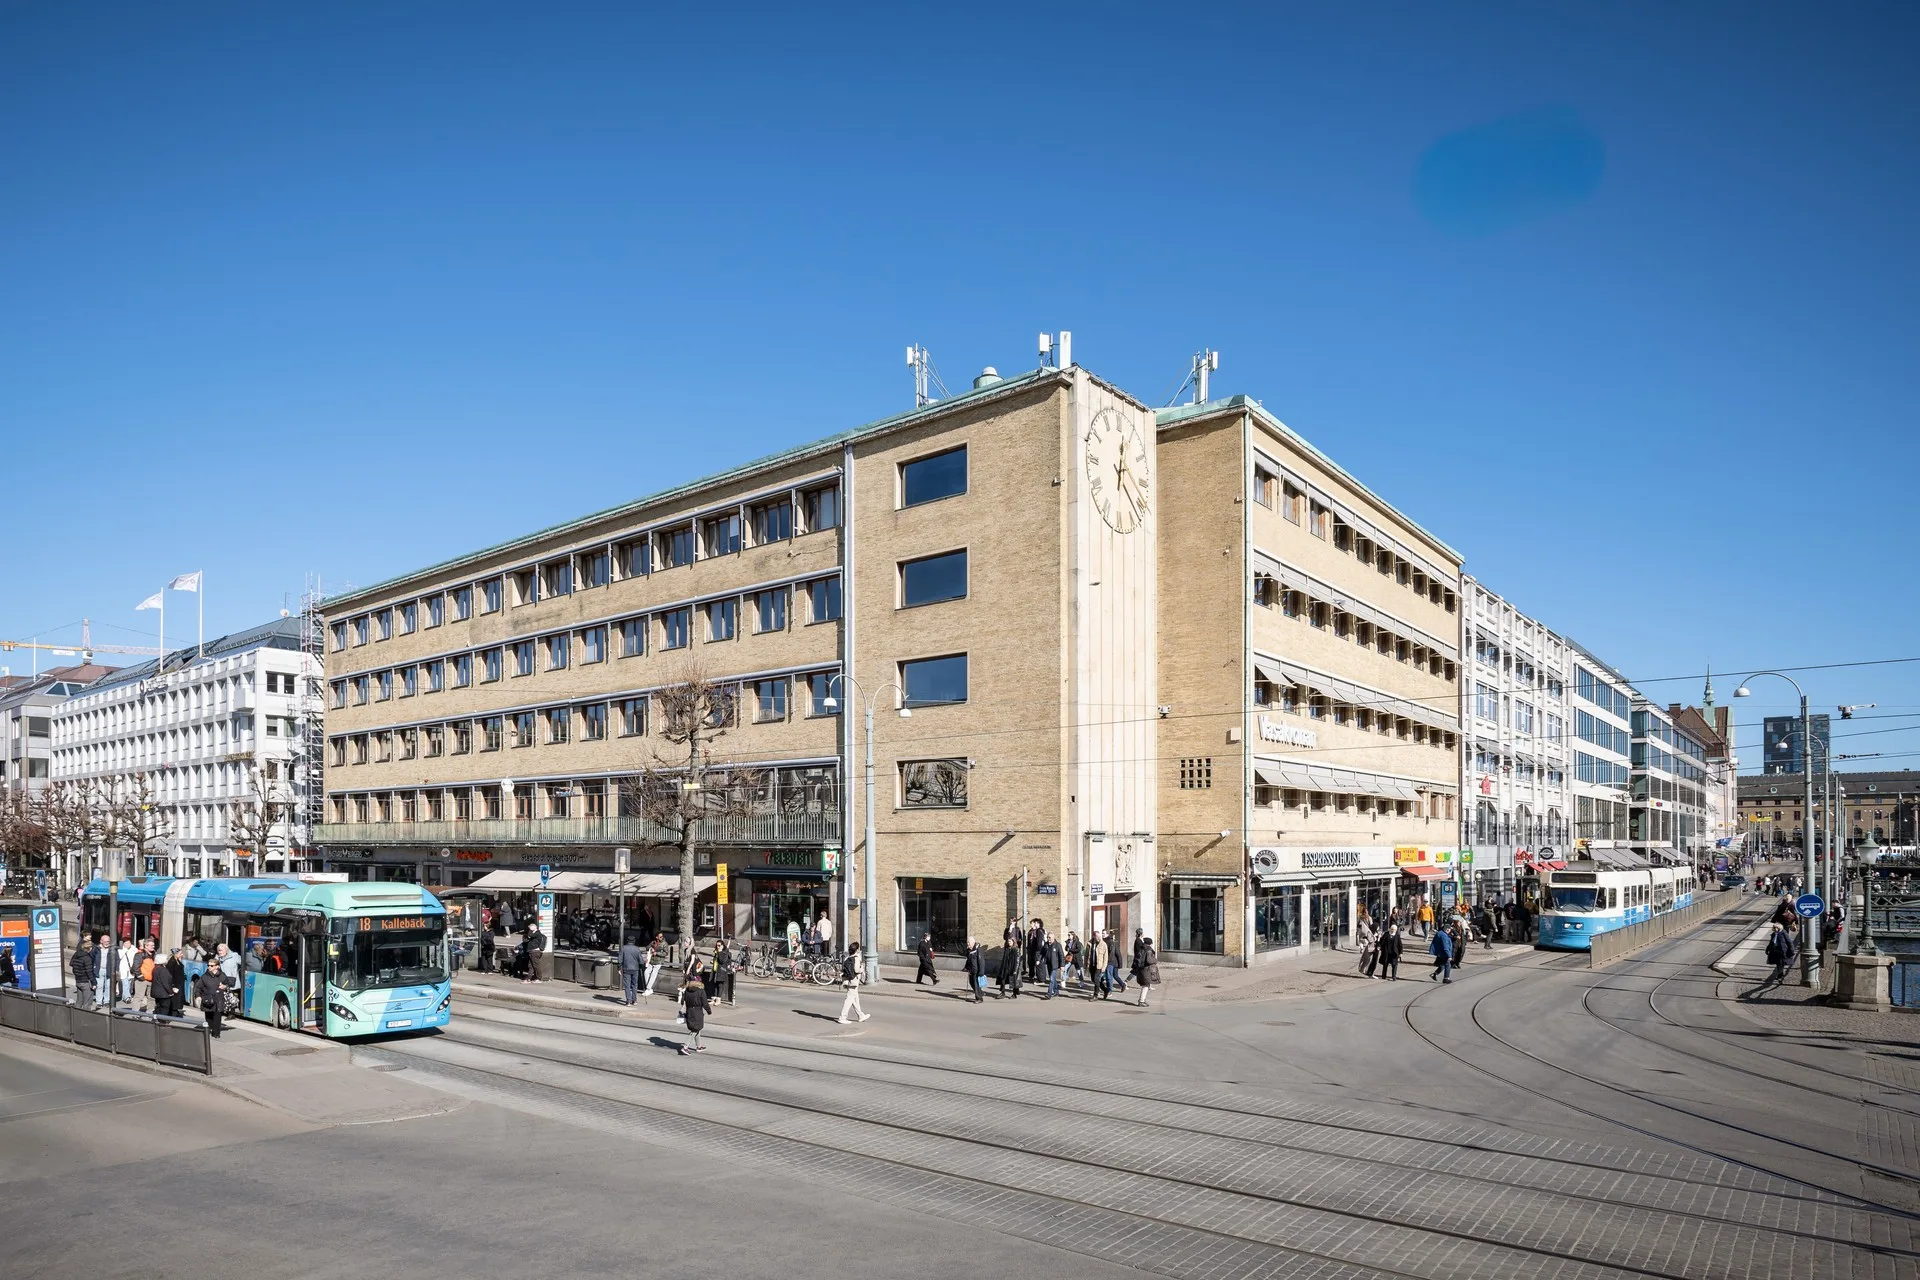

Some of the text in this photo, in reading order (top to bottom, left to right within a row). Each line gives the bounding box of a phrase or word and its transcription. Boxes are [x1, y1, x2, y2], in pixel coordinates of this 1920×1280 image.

[38, 914, 53, 924] A1
[359, 917, 426, 931] 18 Kallebäck
